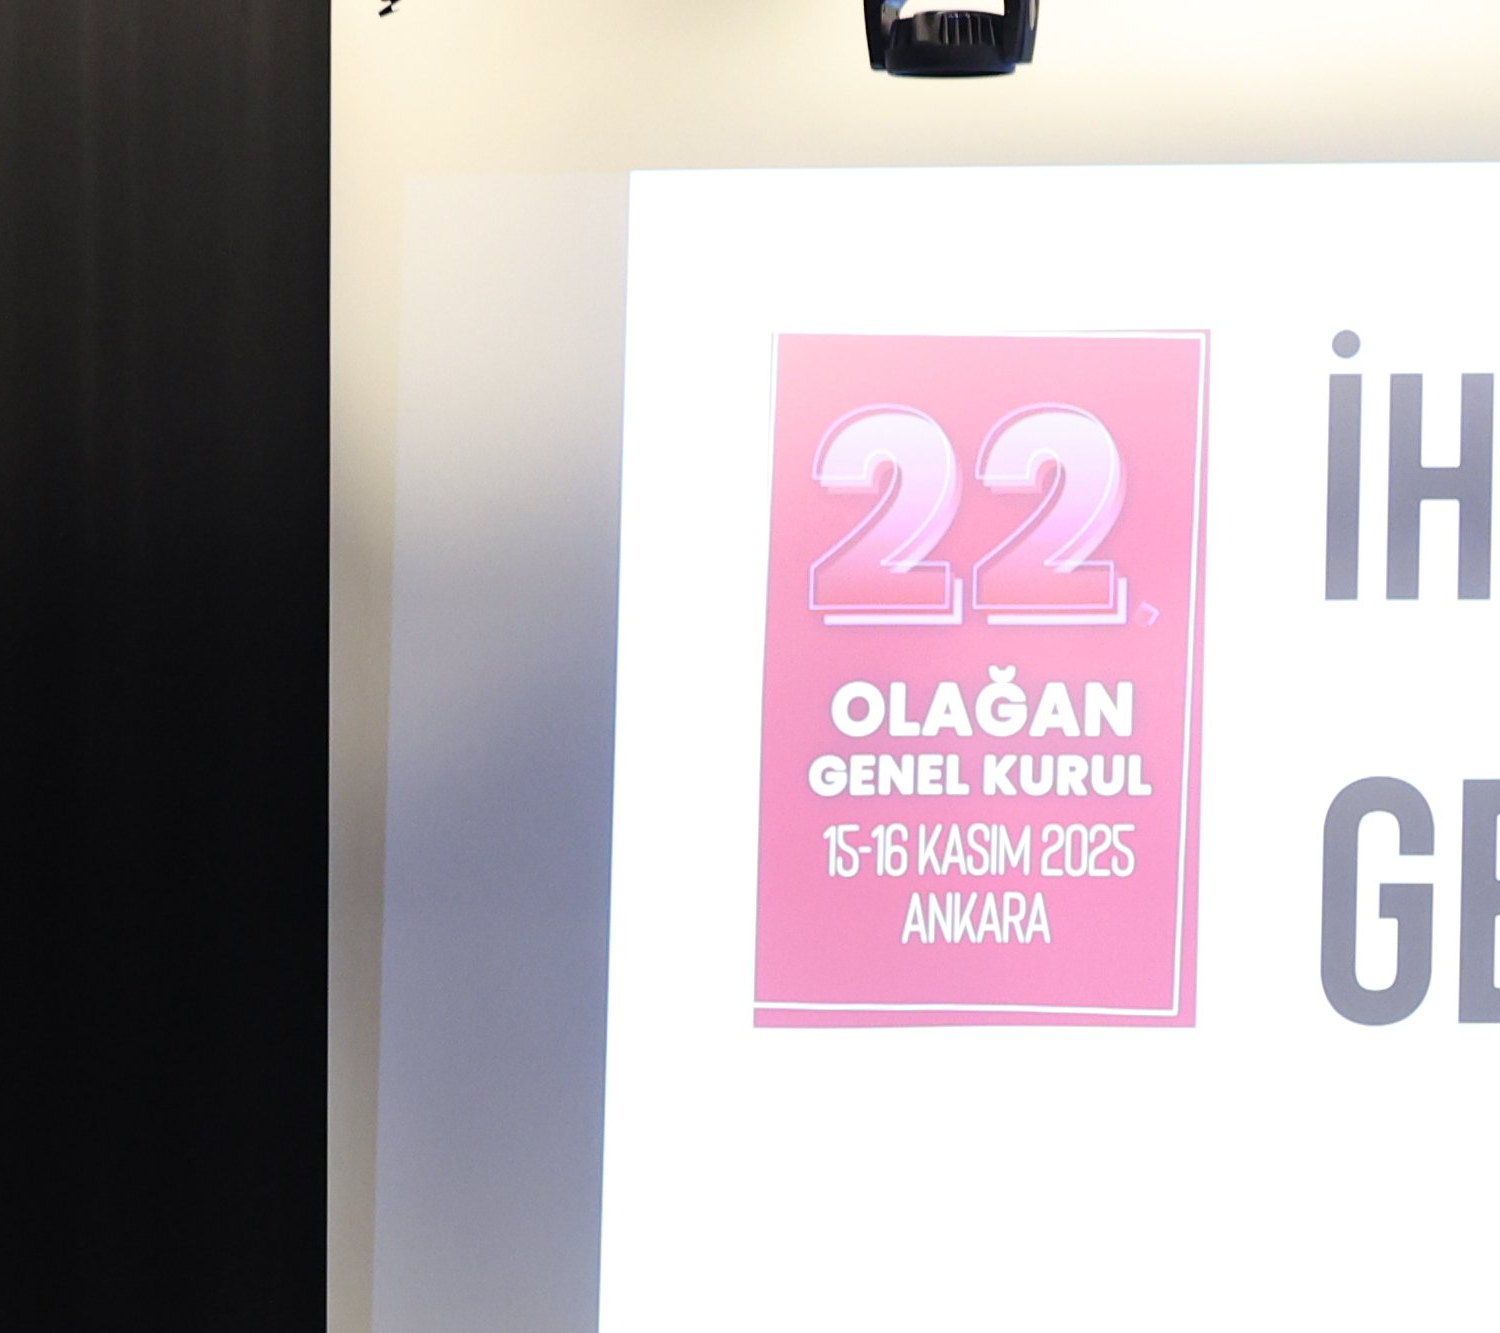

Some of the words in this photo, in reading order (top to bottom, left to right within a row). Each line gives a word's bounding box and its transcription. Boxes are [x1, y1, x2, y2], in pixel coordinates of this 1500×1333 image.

[830, 664, 1134, 738] OLAĞAN
[807, 753, 971, 798] GENEL
[981, 753, 1153, 798] KURUL
[822, 823, 909, 878] 15-16
[917, 823, 1032, 877] KASIM
[1039, 823, 1137, 878] 2025
[900, 892, 1053, 944] ANKARA
